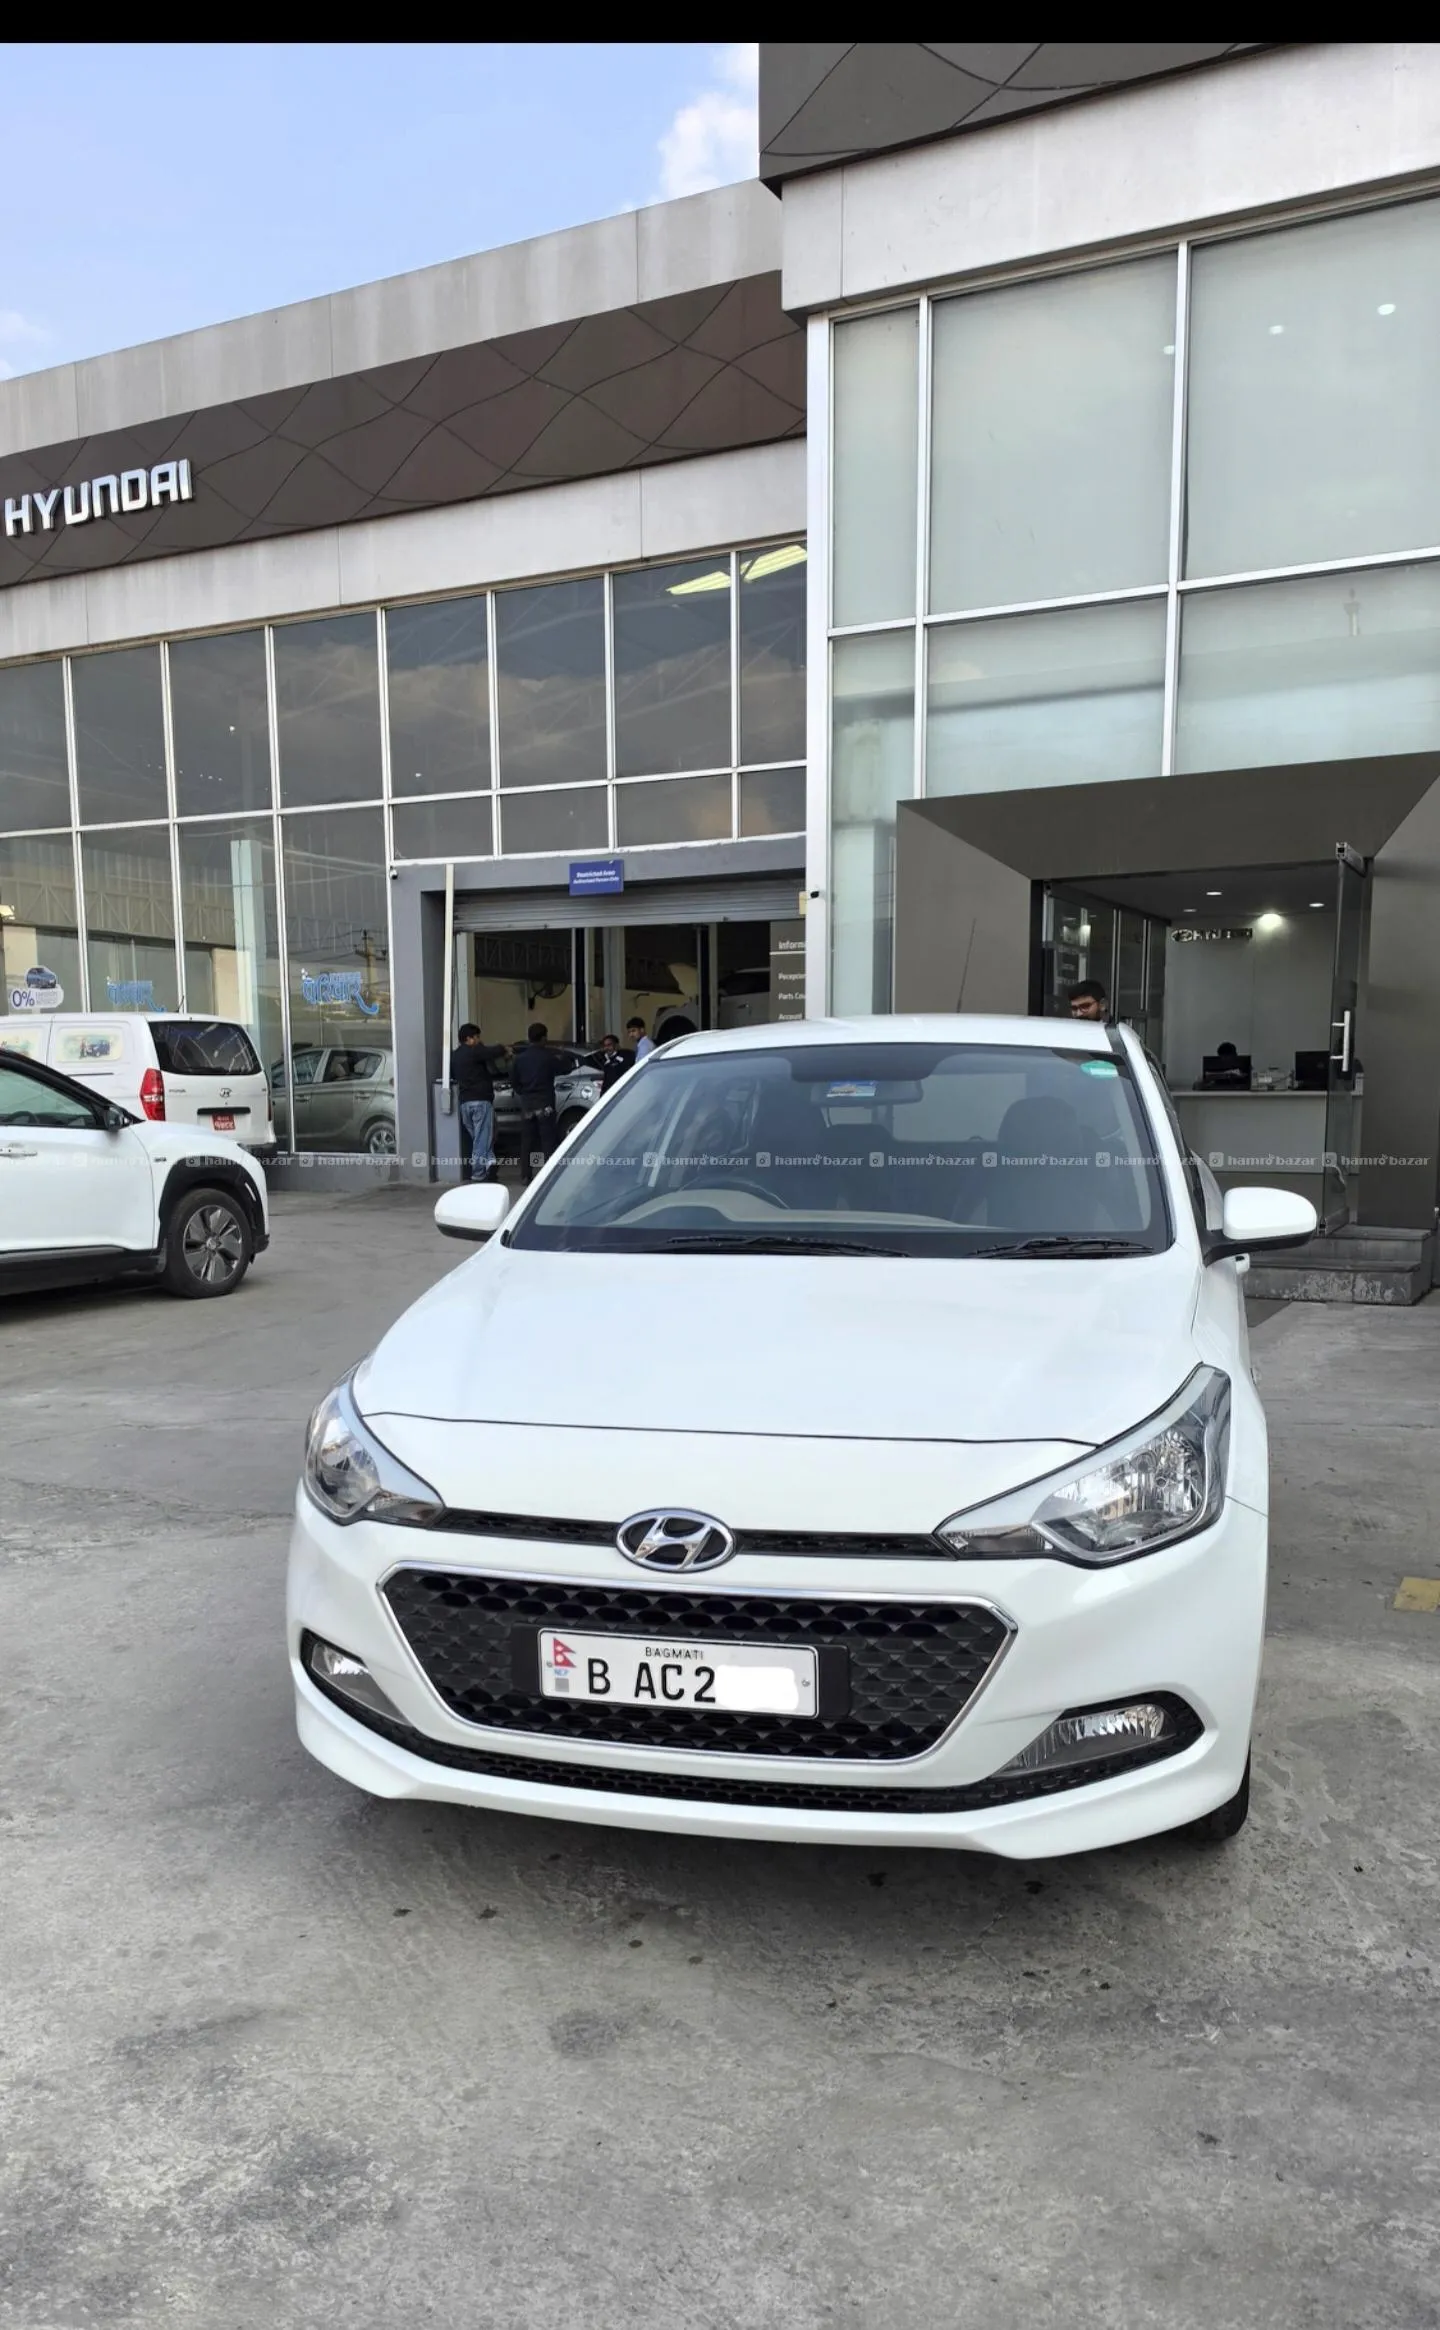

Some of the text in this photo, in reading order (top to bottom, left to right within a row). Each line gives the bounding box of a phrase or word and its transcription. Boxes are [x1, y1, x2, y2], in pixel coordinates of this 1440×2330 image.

[4, 458, 193, 537] HYUNDAI
[12, 990, 35, 1007] 0%
[645, 1646, 704, 1660] BAGMATI
[587, 1657, 611, 1695] B
